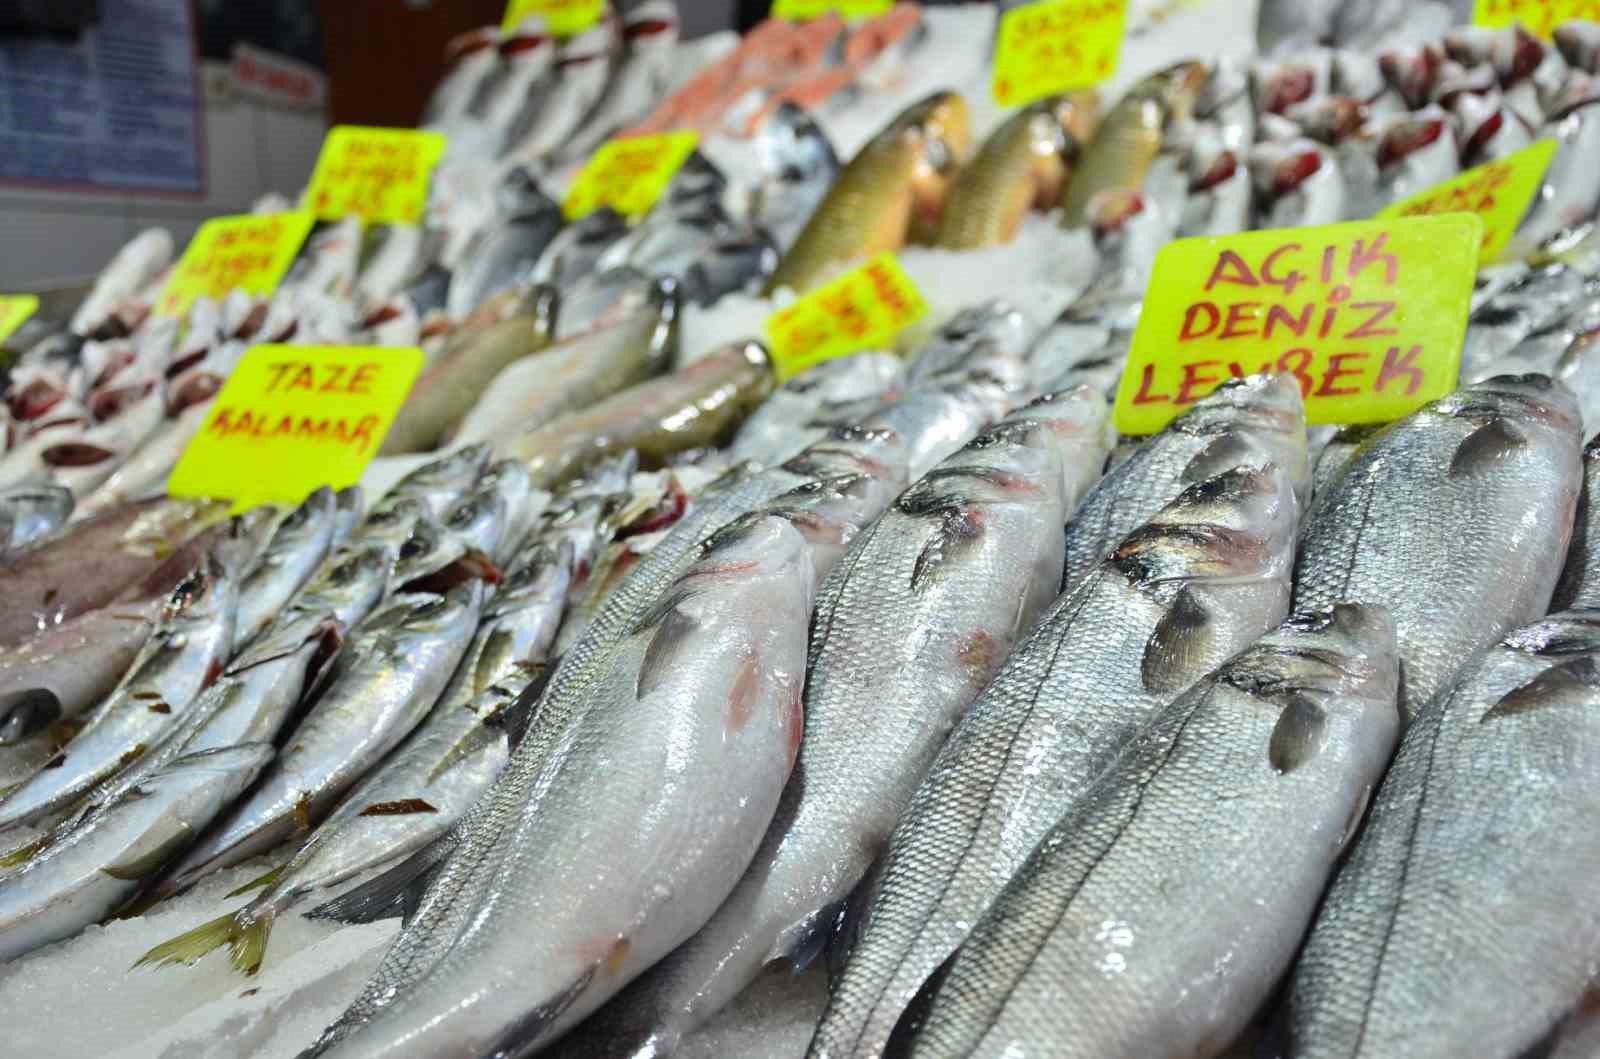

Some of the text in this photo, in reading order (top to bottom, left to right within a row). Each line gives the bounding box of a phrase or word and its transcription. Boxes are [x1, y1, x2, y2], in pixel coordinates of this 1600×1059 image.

[1203, 233, 1398, 294] AÇIK
[267, 362, 382, 394] TAZE
[208, 408, 381, 456] KALAMAR
